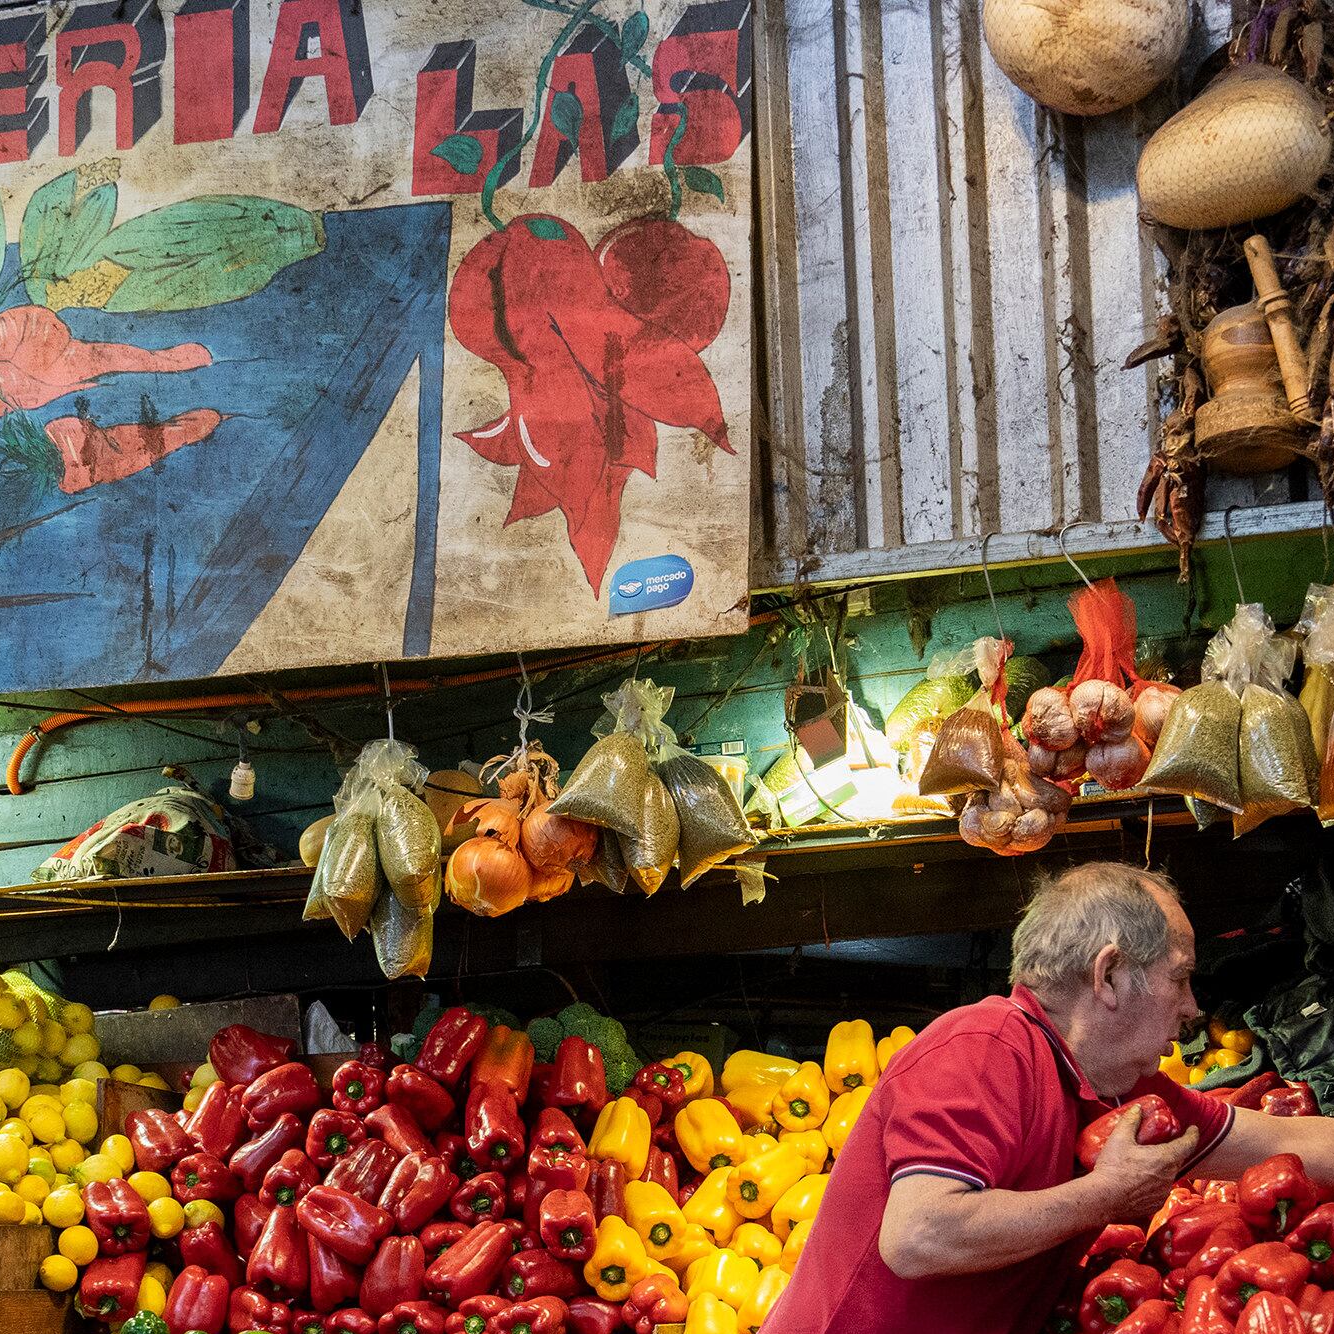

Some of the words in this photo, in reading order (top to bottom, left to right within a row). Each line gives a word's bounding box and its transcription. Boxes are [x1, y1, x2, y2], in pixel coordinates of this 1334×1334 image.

[412, 0, 752, 196] LAS
[646, 570, 687, 584] mercado
[646, 583, 670, 595] pago
